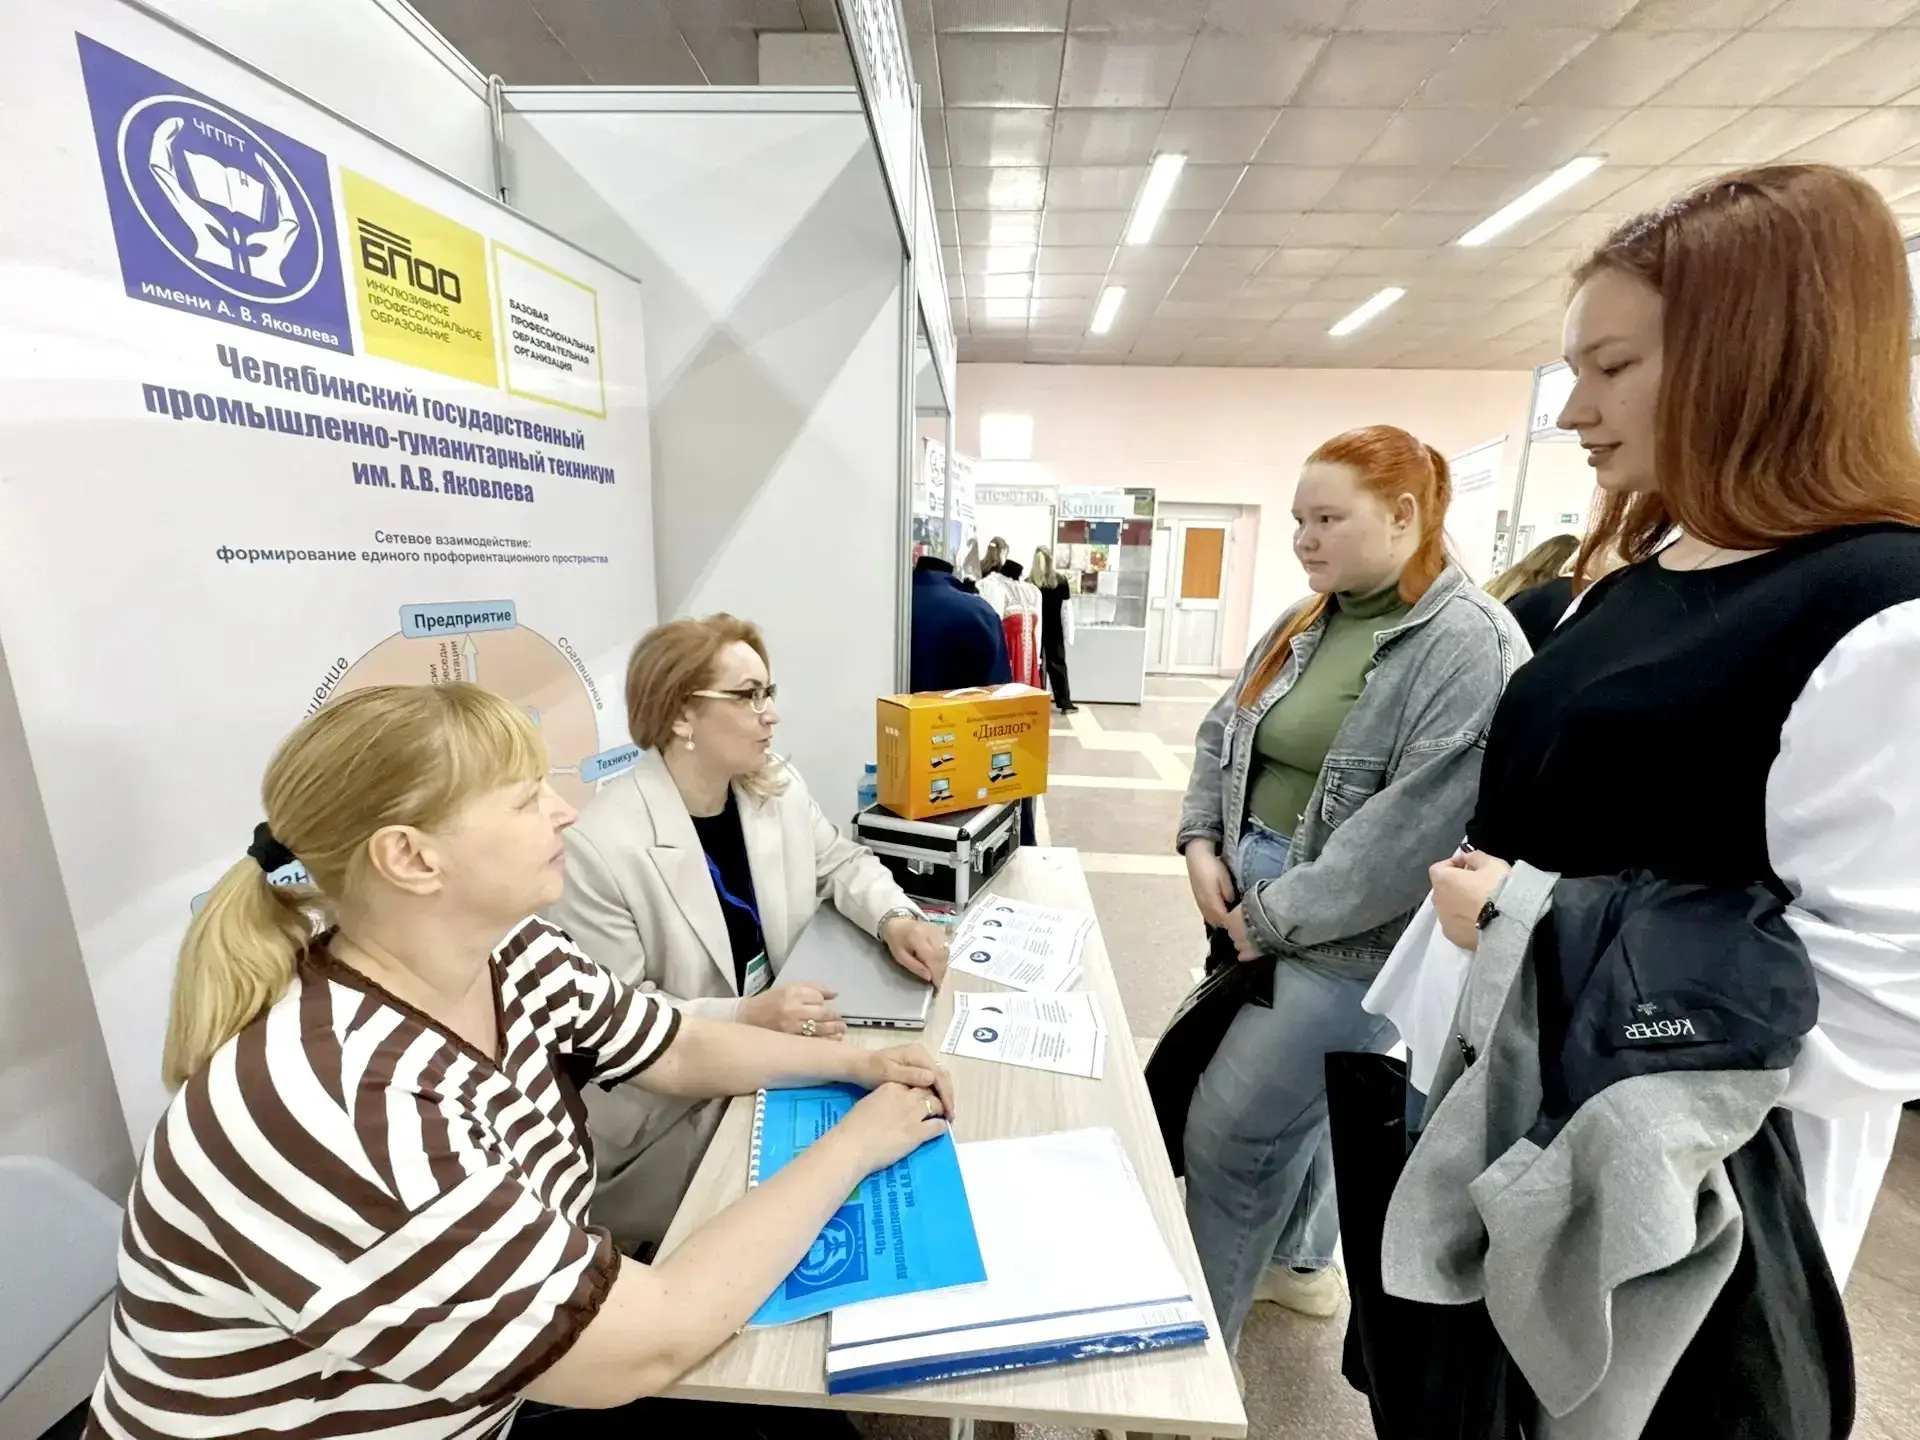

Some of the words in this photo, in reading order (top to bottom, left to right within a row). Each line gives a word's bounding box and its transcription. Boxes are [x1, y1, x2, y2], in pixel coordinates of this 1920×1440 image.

[192, 117, 245, 152] ЧГПГТ
[359, 233, 462, 304] БПОО
[141, 281, 212, 312] имени
[217, 299, 236, 318] А.
[240, 305, 257, 325] В.
[261, 312, 339, 347] Яковлева
[366, 277, 450, 317] ИНКЛЮЗИВНОЕ
[509, 298, 550, 323] БАЗОВАЯ
[368, 292, 483, 341] ПРОФЕССИОНАЛЬНОЕ
[370, 308, 451, 344] ОБРАЗОВАНИЕ
[510, 314, 596, 355] ПРОФЕССИОНАЛЬНАЯ
[512, 330, 590, 365] ОБРАЗОВАТЕЛЬНАЯ
[514, 345, 573, 373] ОРГАНИЗАЦИЯ
[216, 343, 419, 417] Челябинский
[423, 397, 586, 451] государственный
[141, 383, 546, 474] промышленно-гуманитарный
[548, 456, 616, 485] техникум
[1536, 413, 1549, 428] 13
[352, 461, 396, 489] им.
[400, 464, 440, 493] А.В.
[443, 470, 535, 504] Яковлева
[216, 545, 357, 564] формирование
[361, 550, 420, 563] единого
[423, 551, 551, 564] профориентационного
[552, 555, 609, 565] пространства
[374, 530, 432, 544] Сетевое
[435, 535, 532, 549] взаимодействие:
[414, 609, 513, 632] Предприятие
[303, 657, 349, 719] шение
[558, 636, 604, 711] Соглашение
[596, 749, 640, 771] Техникум
[1623, 1018, 1696, 1040] KASPER
